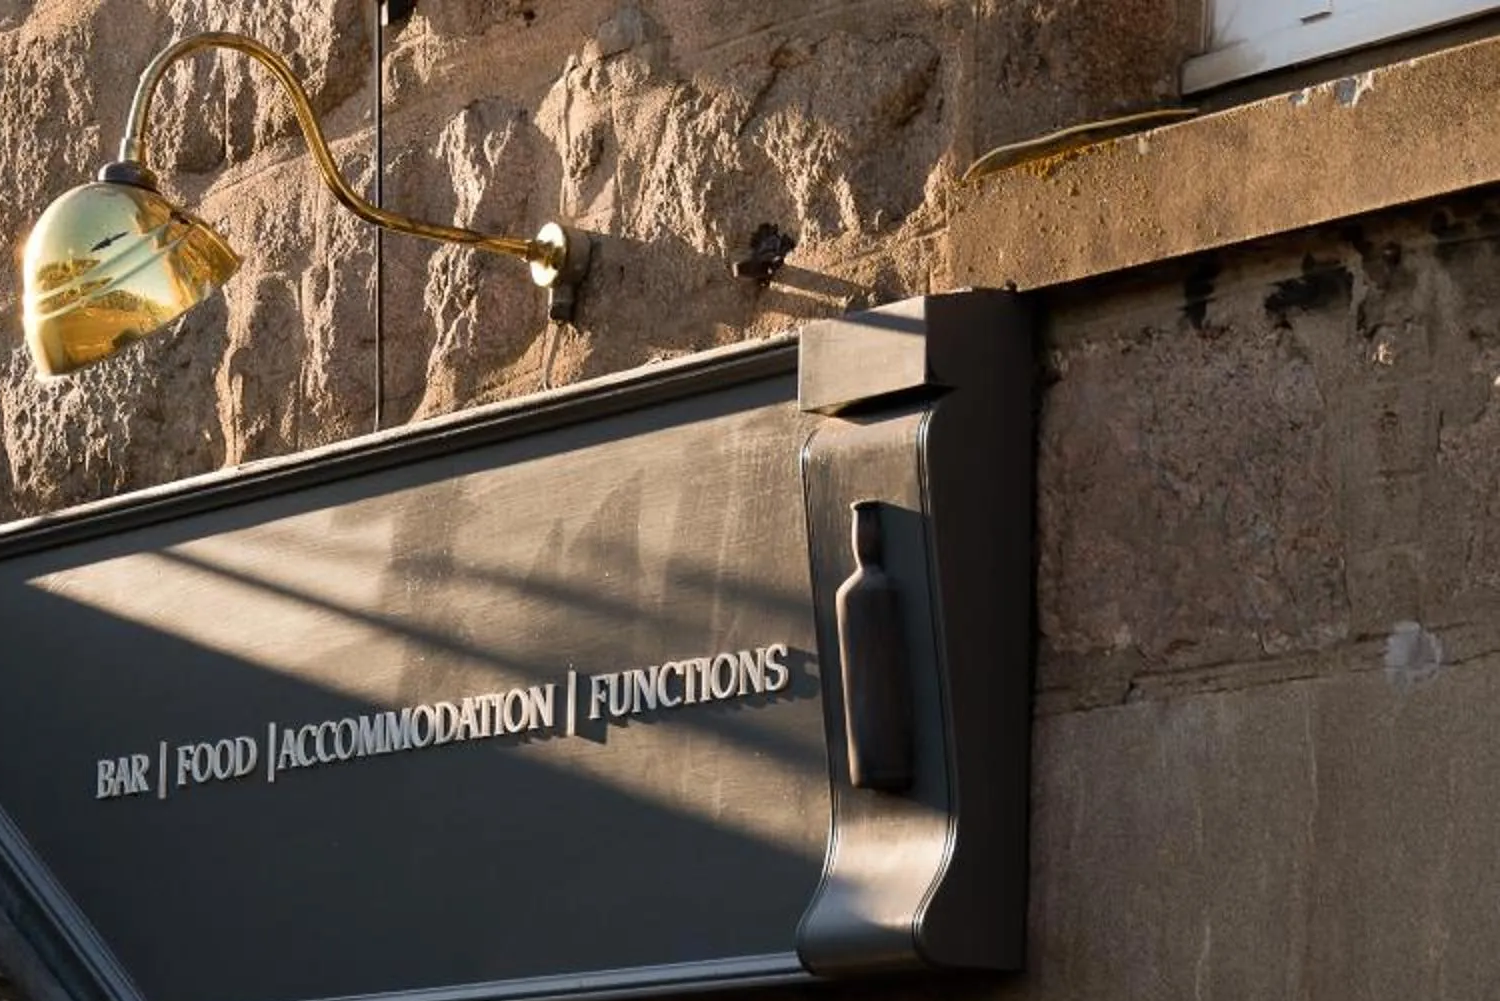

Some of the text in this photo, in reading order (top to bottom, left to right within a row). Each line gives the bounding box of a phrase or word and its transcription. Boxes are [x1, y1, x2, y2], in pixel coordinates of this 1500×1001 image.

[95, 643, 790, 799] BAR FOOD ACCOMMODATION FUNCTIONS
